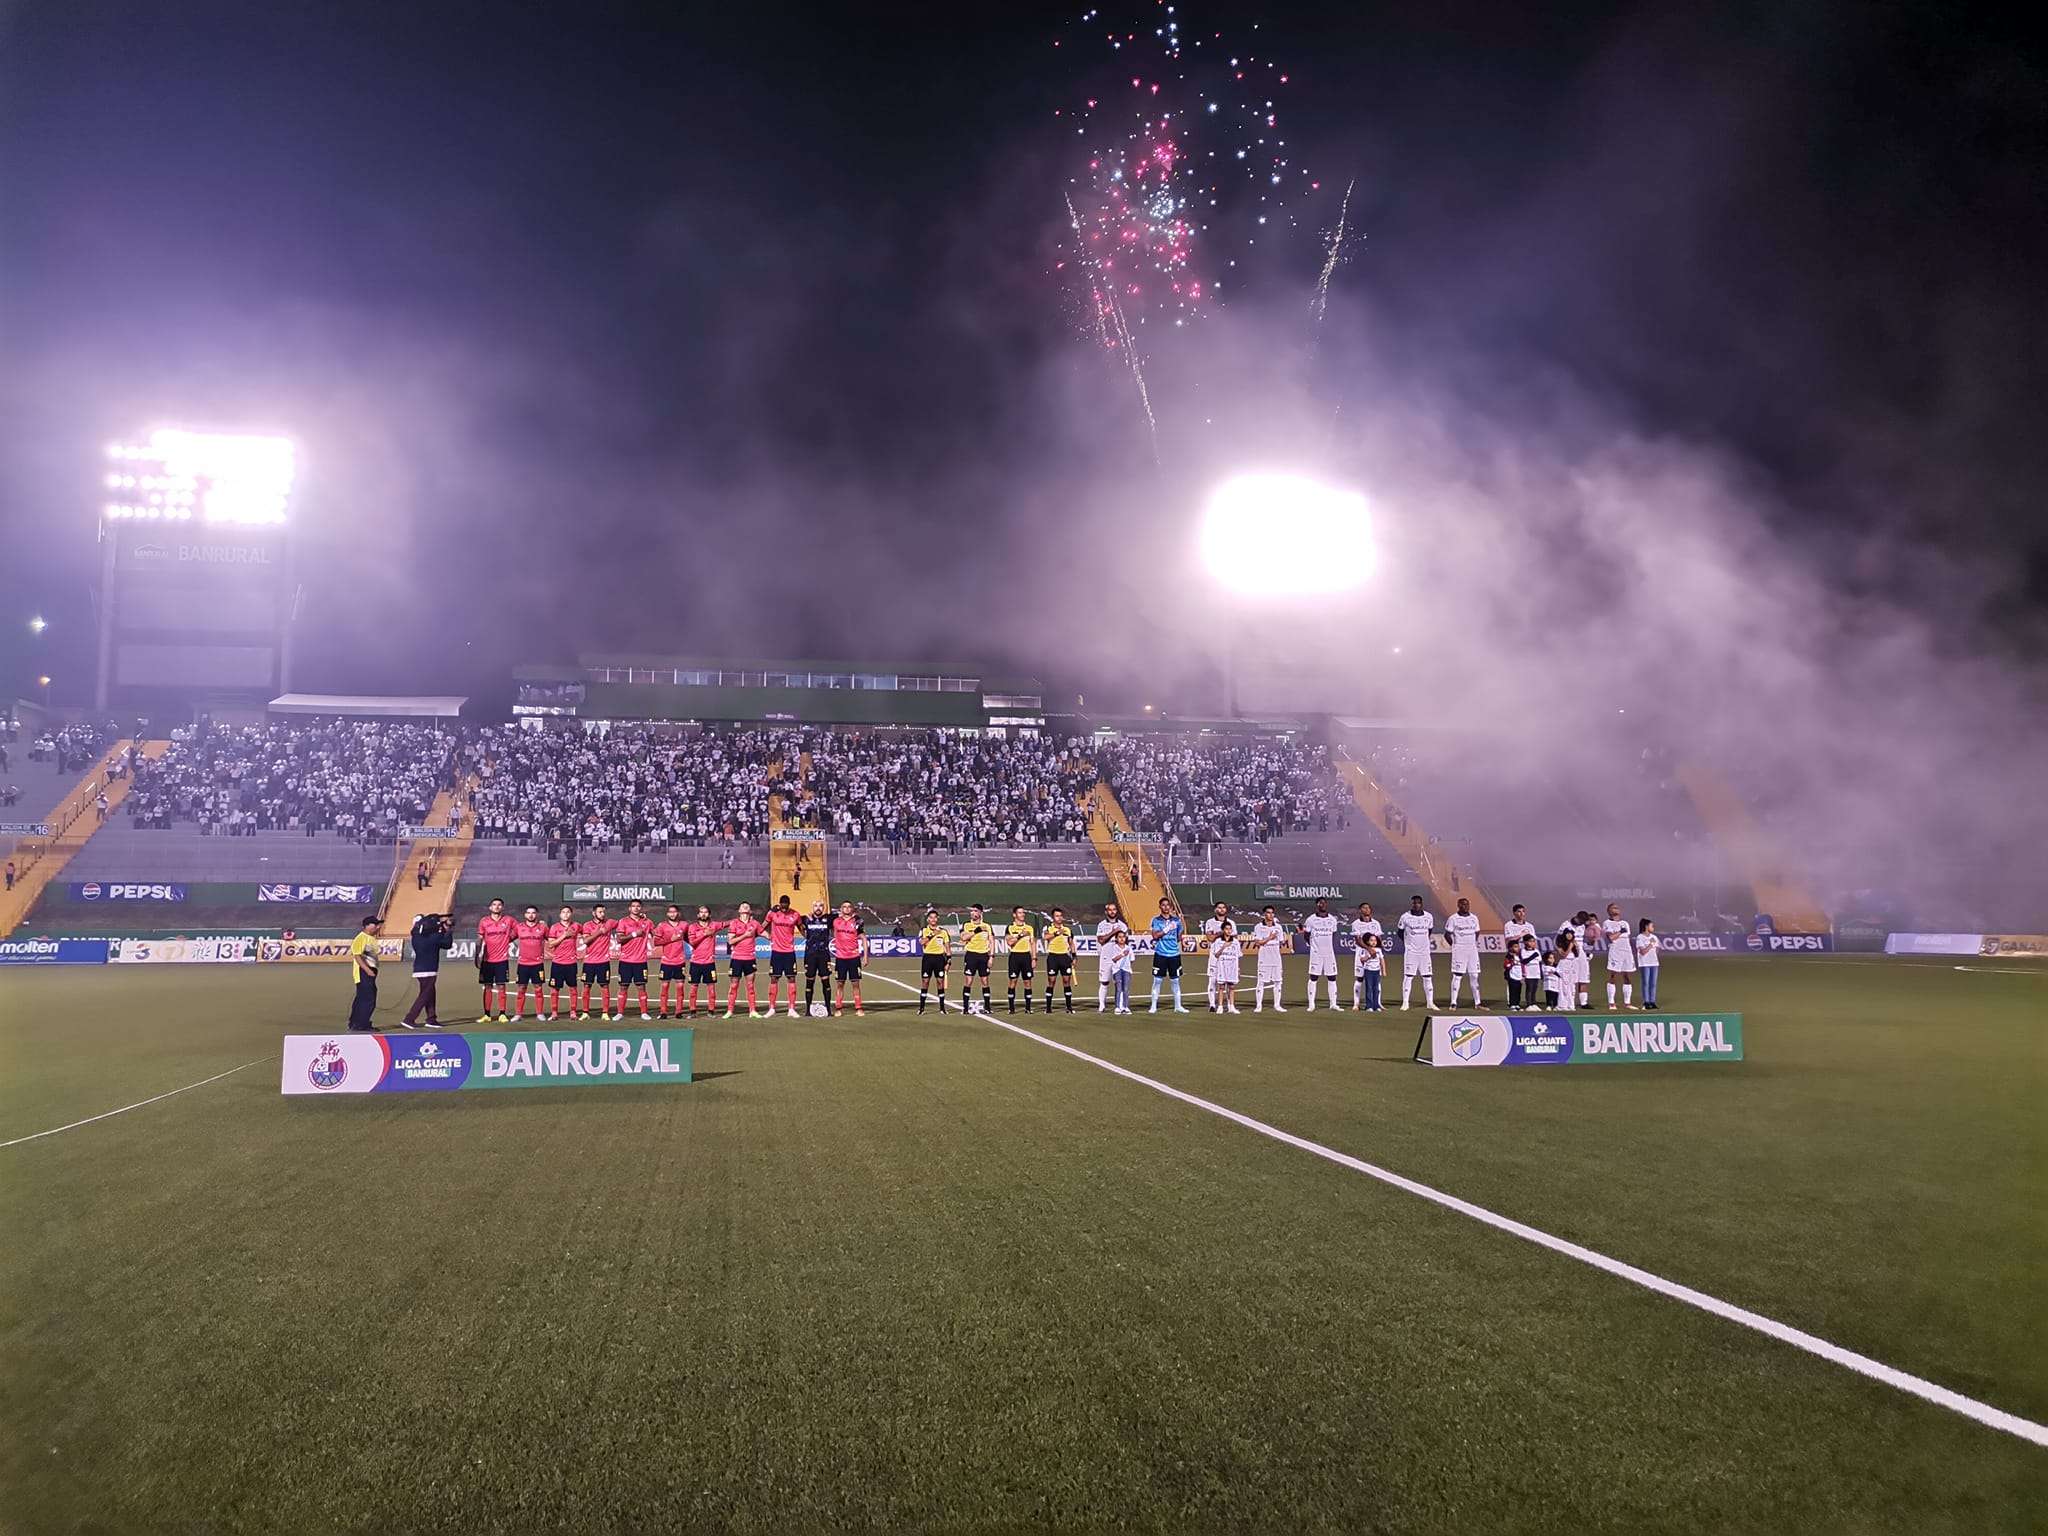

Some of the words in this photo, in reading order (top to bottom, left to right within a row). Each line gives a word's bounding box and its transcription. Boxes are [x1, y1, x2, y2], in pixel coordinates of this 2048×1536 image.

[178, 545, 271, 563] BANRURAL
[36, 825, 48, 835] 16
[446, 827, 457, 838] 15
[814, 830, 825, 840] 14
[110, 885, 173, 900] PEPSI
[603, 887, 666, 899] BANRURAL
[1289, 886, 1342, 897] BANRURAL
[0, 941, 59, 953] molten
[1688, 937, 1727, 950] BELL
[1770, 936, 1823, 950] PEPSI
[1516, 1037, 1537, 1045] LIGA
[1538, 1036, 1567, 1045] GUATE
[1583, 1021, 1733, 1054] BANRURAL
[395, 1060, 421, 1069] LIGA
[424, 1058, 462, 1068] GUATE
[484, 1038, 680, 1078] BANRURAL
